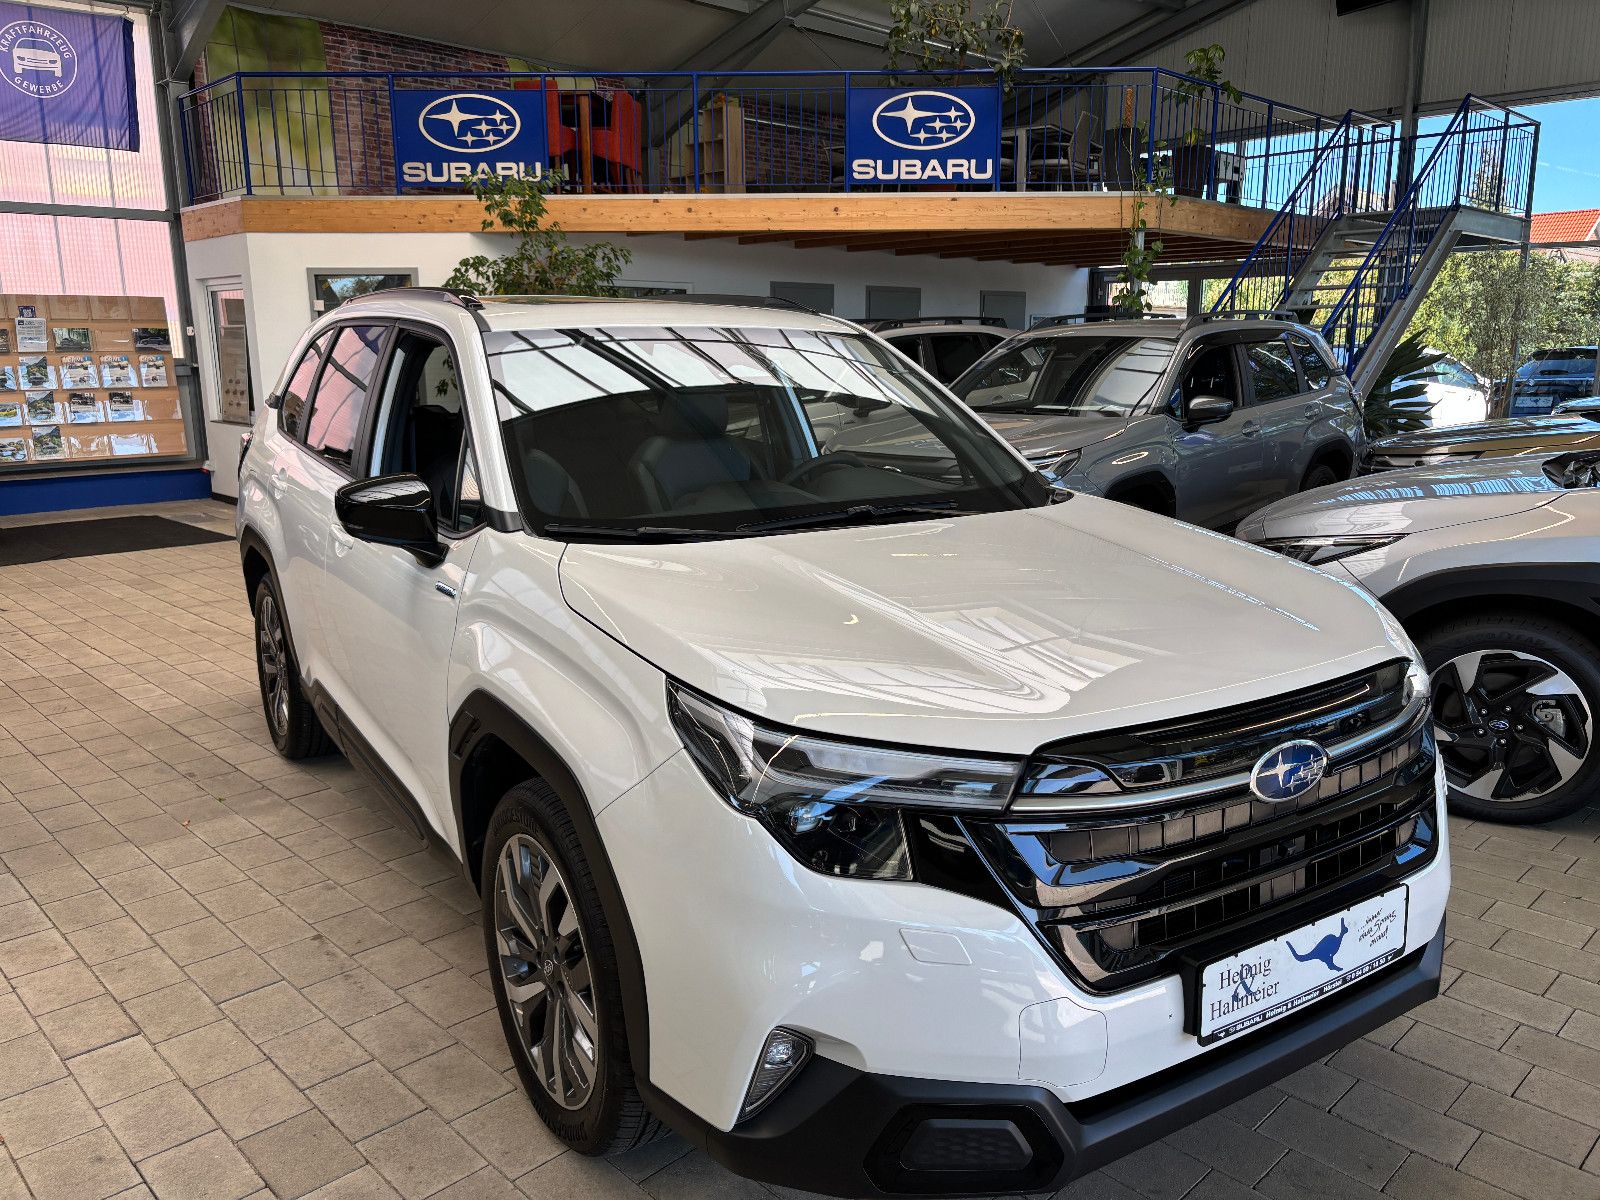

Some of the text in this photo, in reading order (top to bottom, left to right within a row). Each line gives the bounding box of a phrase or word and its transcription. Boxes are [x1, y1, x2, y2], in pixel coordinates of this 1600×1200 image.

[0, 25, 73, 59] KRAFTFAHRZEUG
[14, 76, 64, 94] GEWERBE
[402, 161, 542, 183] SUBARU
[852, 158, 993, 180] SUBARU
